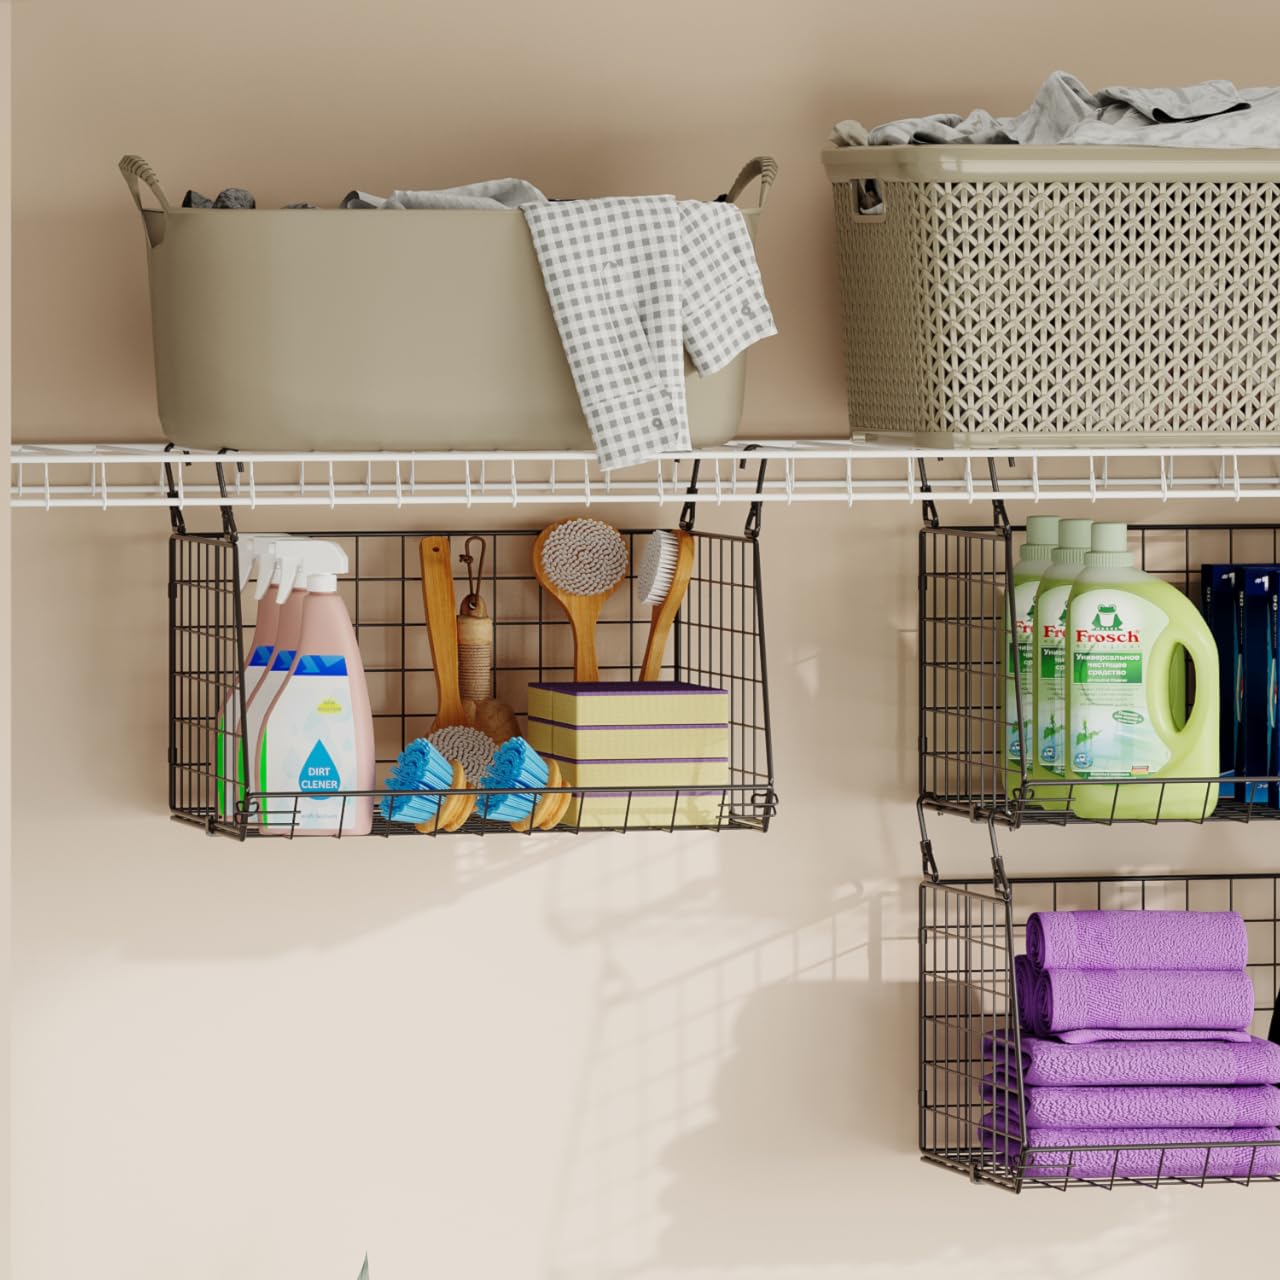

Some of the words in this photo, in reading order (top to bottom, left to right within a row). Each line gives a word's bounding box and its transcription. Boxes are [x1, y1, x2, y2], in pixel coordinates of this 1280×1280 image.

[1075, 629, 1140, 643] Frosch
[308, 767, 331, 776] DIRT
[301, 780, 338, 789] CLENER
